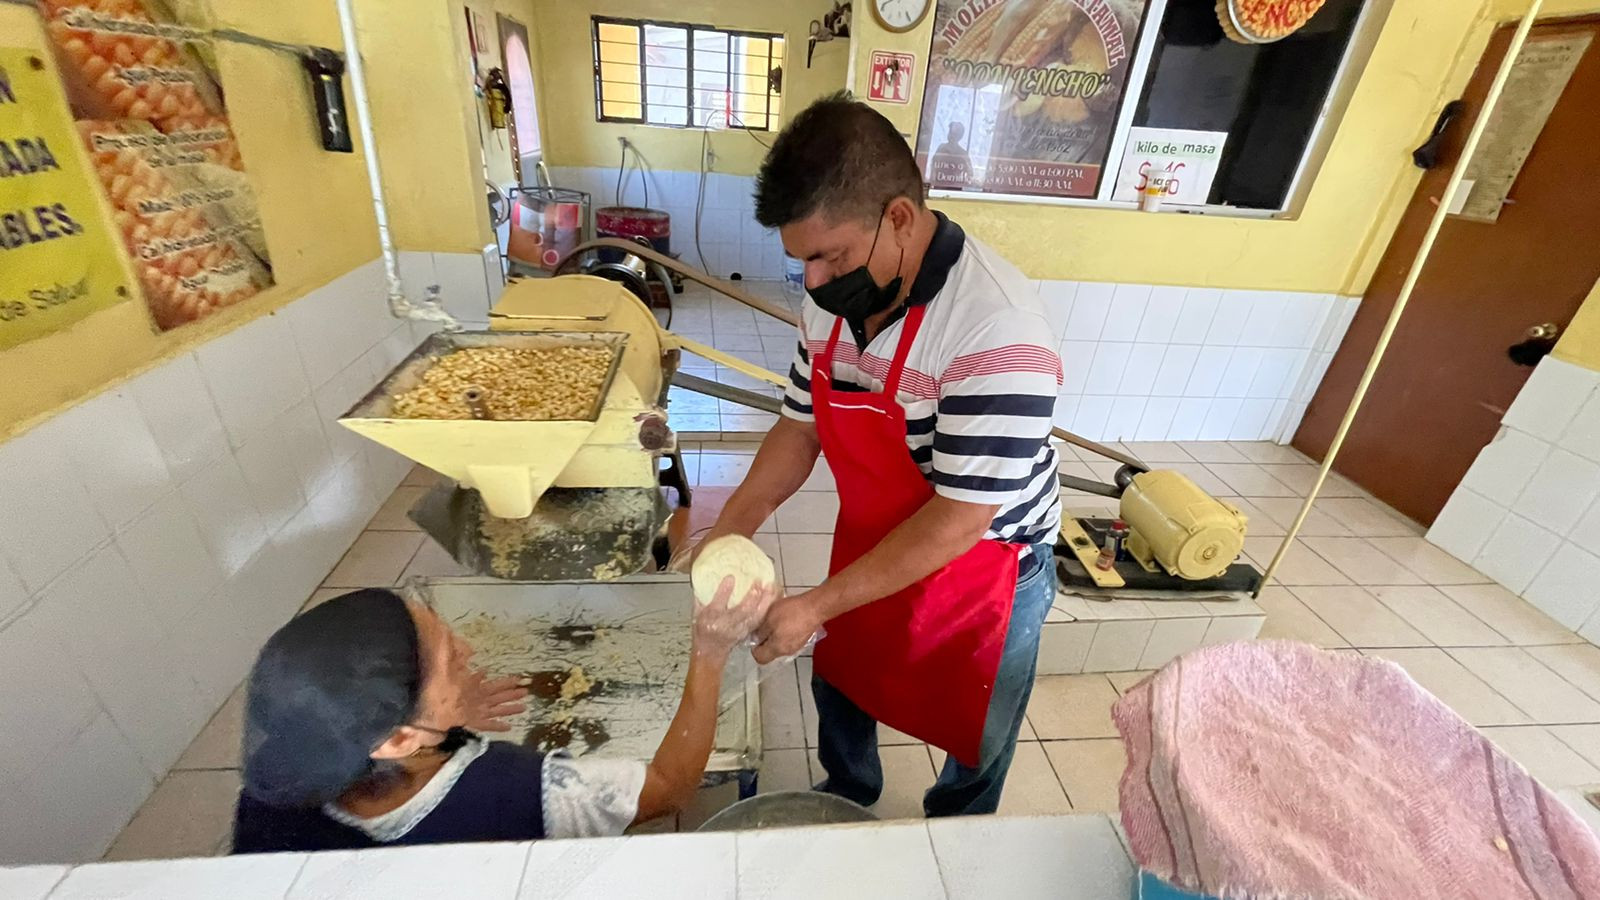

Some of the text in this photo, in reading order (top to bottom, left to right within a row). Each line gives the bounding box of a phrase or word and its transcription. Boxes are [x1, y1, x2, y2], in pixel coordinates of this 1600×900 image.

[1076, 0, 1126, 69] TAMAL
[1137, 141, 1216, 154] kilo de masa
